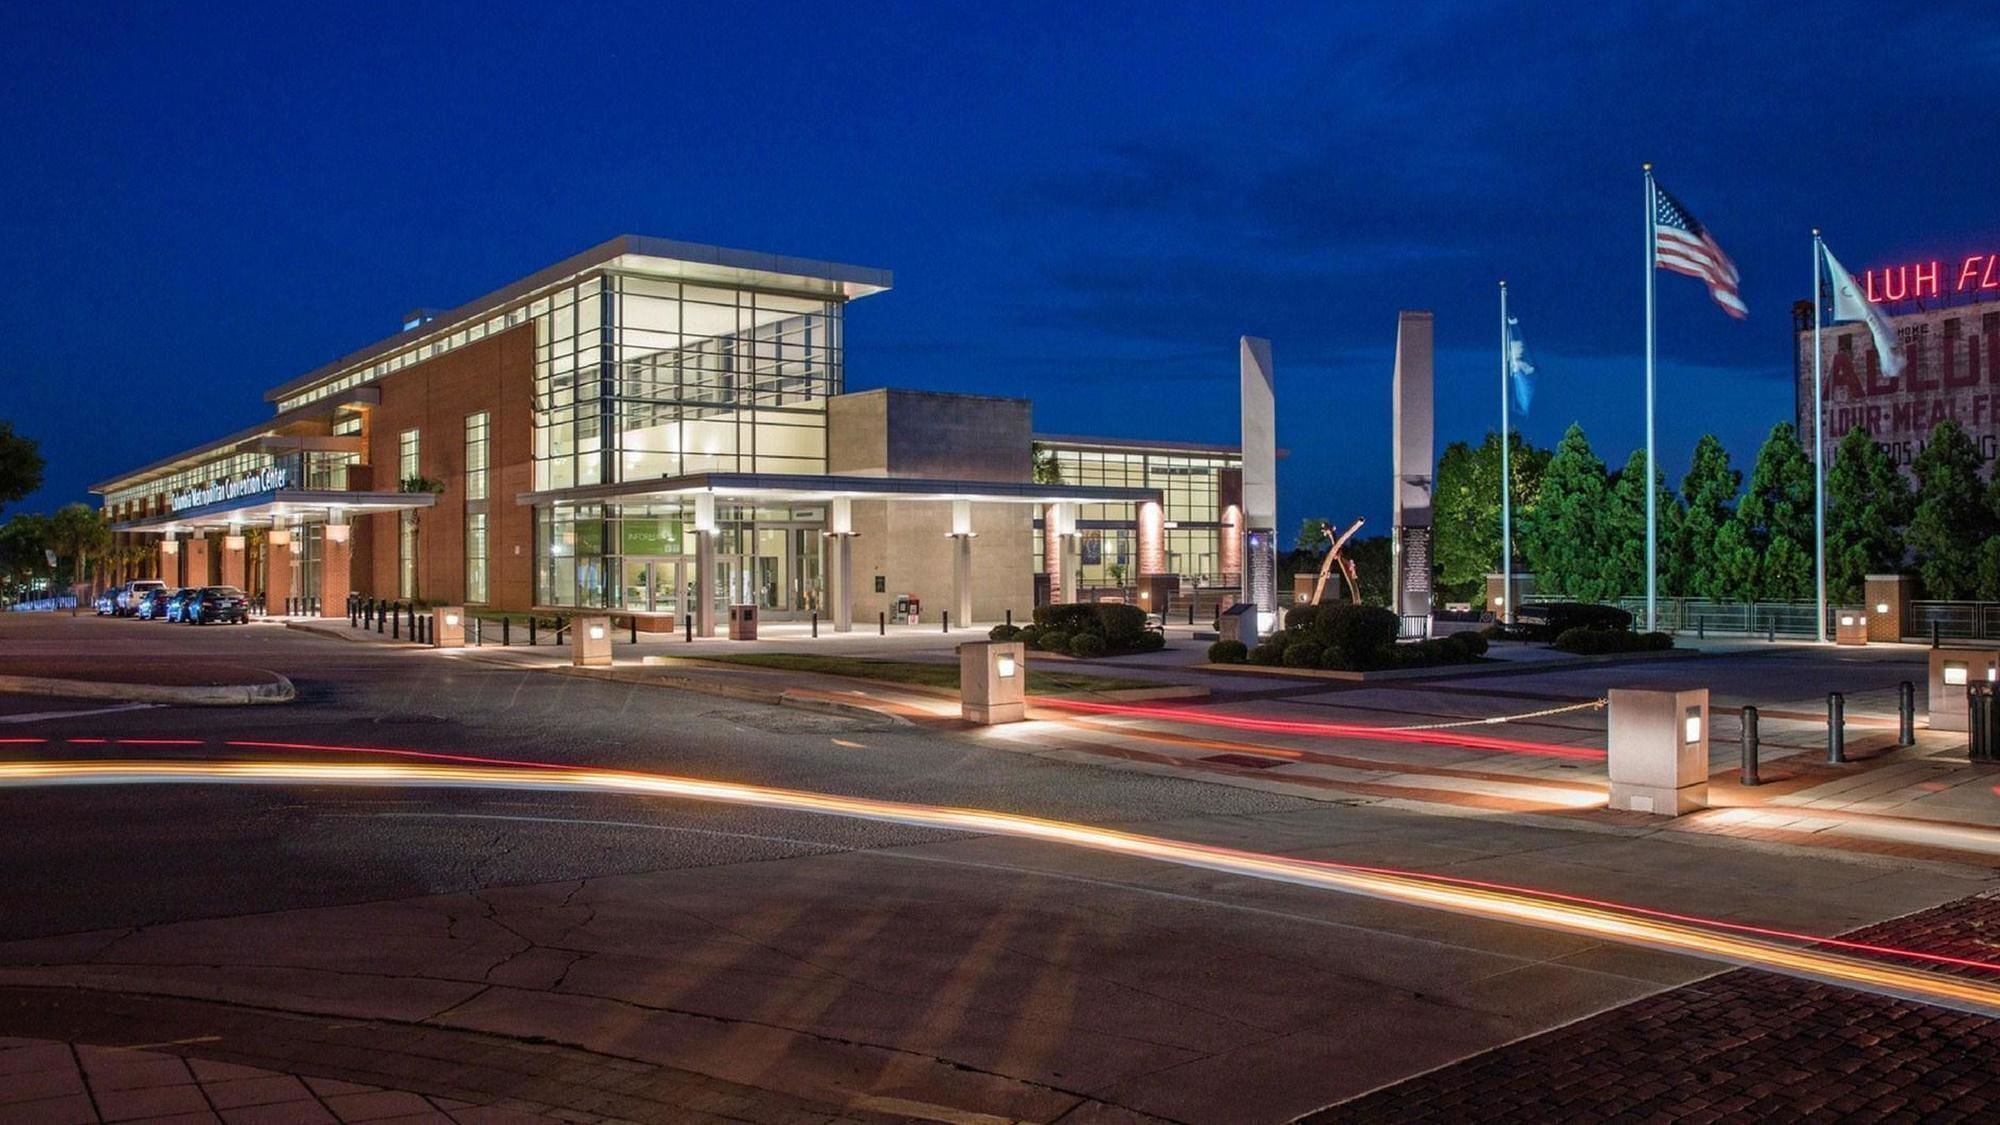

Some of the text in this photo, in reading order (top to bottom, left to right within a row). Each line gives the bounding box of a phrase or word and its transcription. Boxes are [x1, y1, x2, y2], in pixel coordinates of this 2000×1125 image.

[1897, 323, 1929, 337] HOME
[225, 472, 260, 500] Convention
[261, 468, 286, 491] Center
